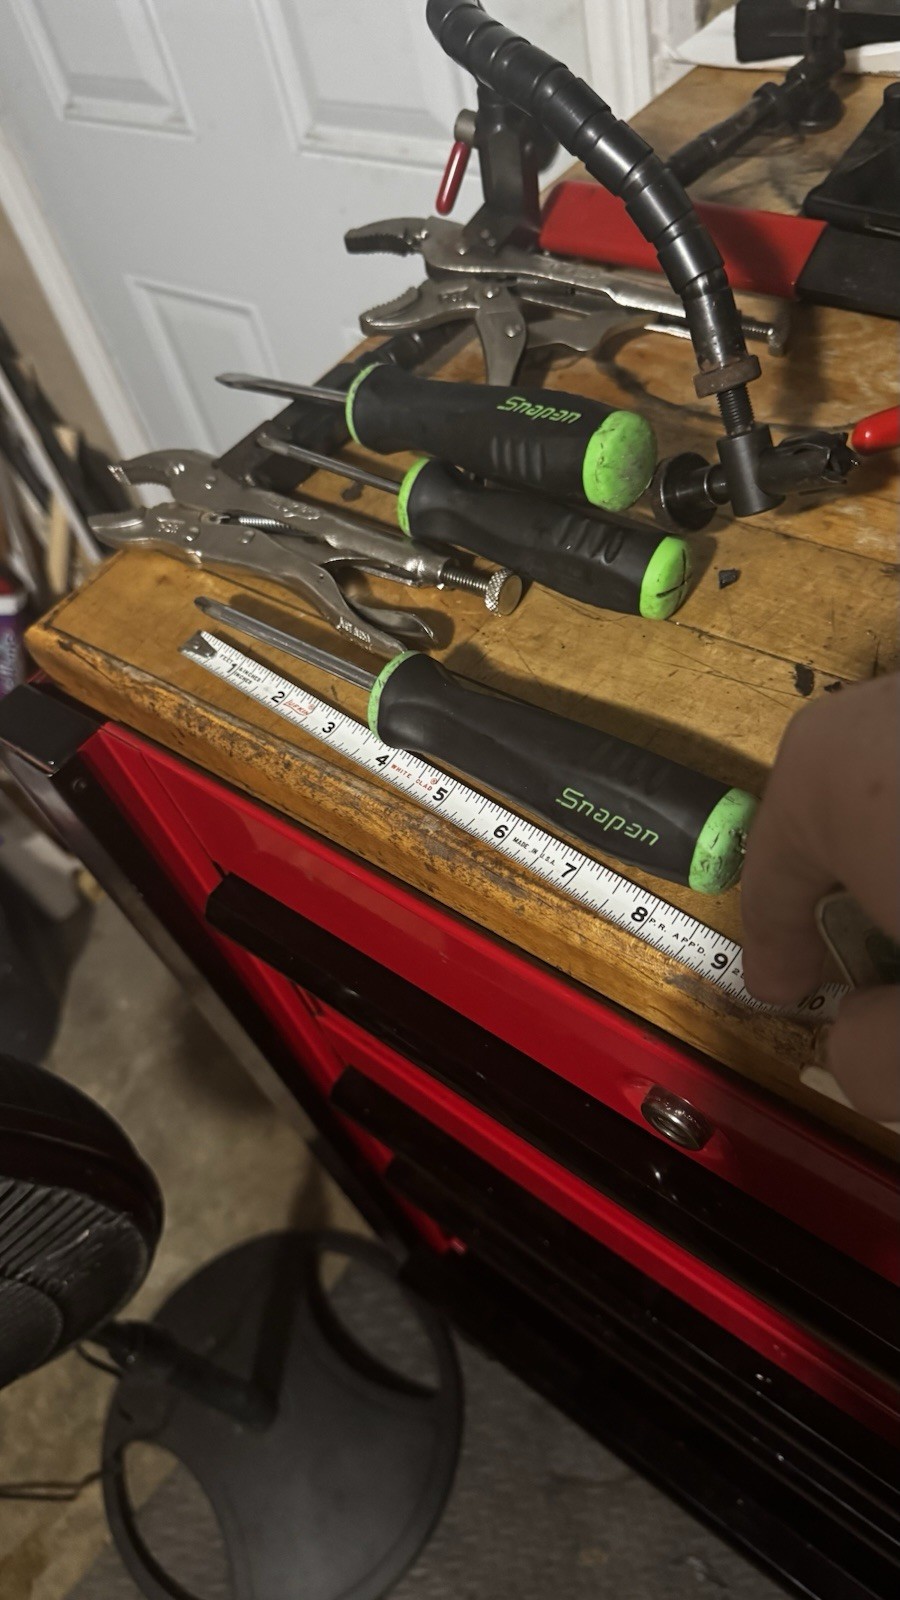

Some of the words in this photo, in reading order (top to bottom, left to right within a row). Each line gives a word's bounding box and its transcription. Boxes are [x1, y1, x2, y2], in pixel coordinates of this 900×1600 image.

[227, 663, 238, 674] 1
[271, 691, 285, 703] 2
[322, 721, 336, 733] 3
[375, 755, 390, 766] 4
[390, 763, 412, 779] WHITE
[432, 787, 448, 802] 5
[493, 824, 509, 839] 6
[512, 836, 530, 850] MADE
[561, 862, 577, 878] 7
[631, 906, 648, 922] 8
[648, 917, 667, 932] P.R.
[672, 933, 707, 956] APP'D.
[710, 952, 728, 970] 9
[797, 995, 826, 1011] 10
